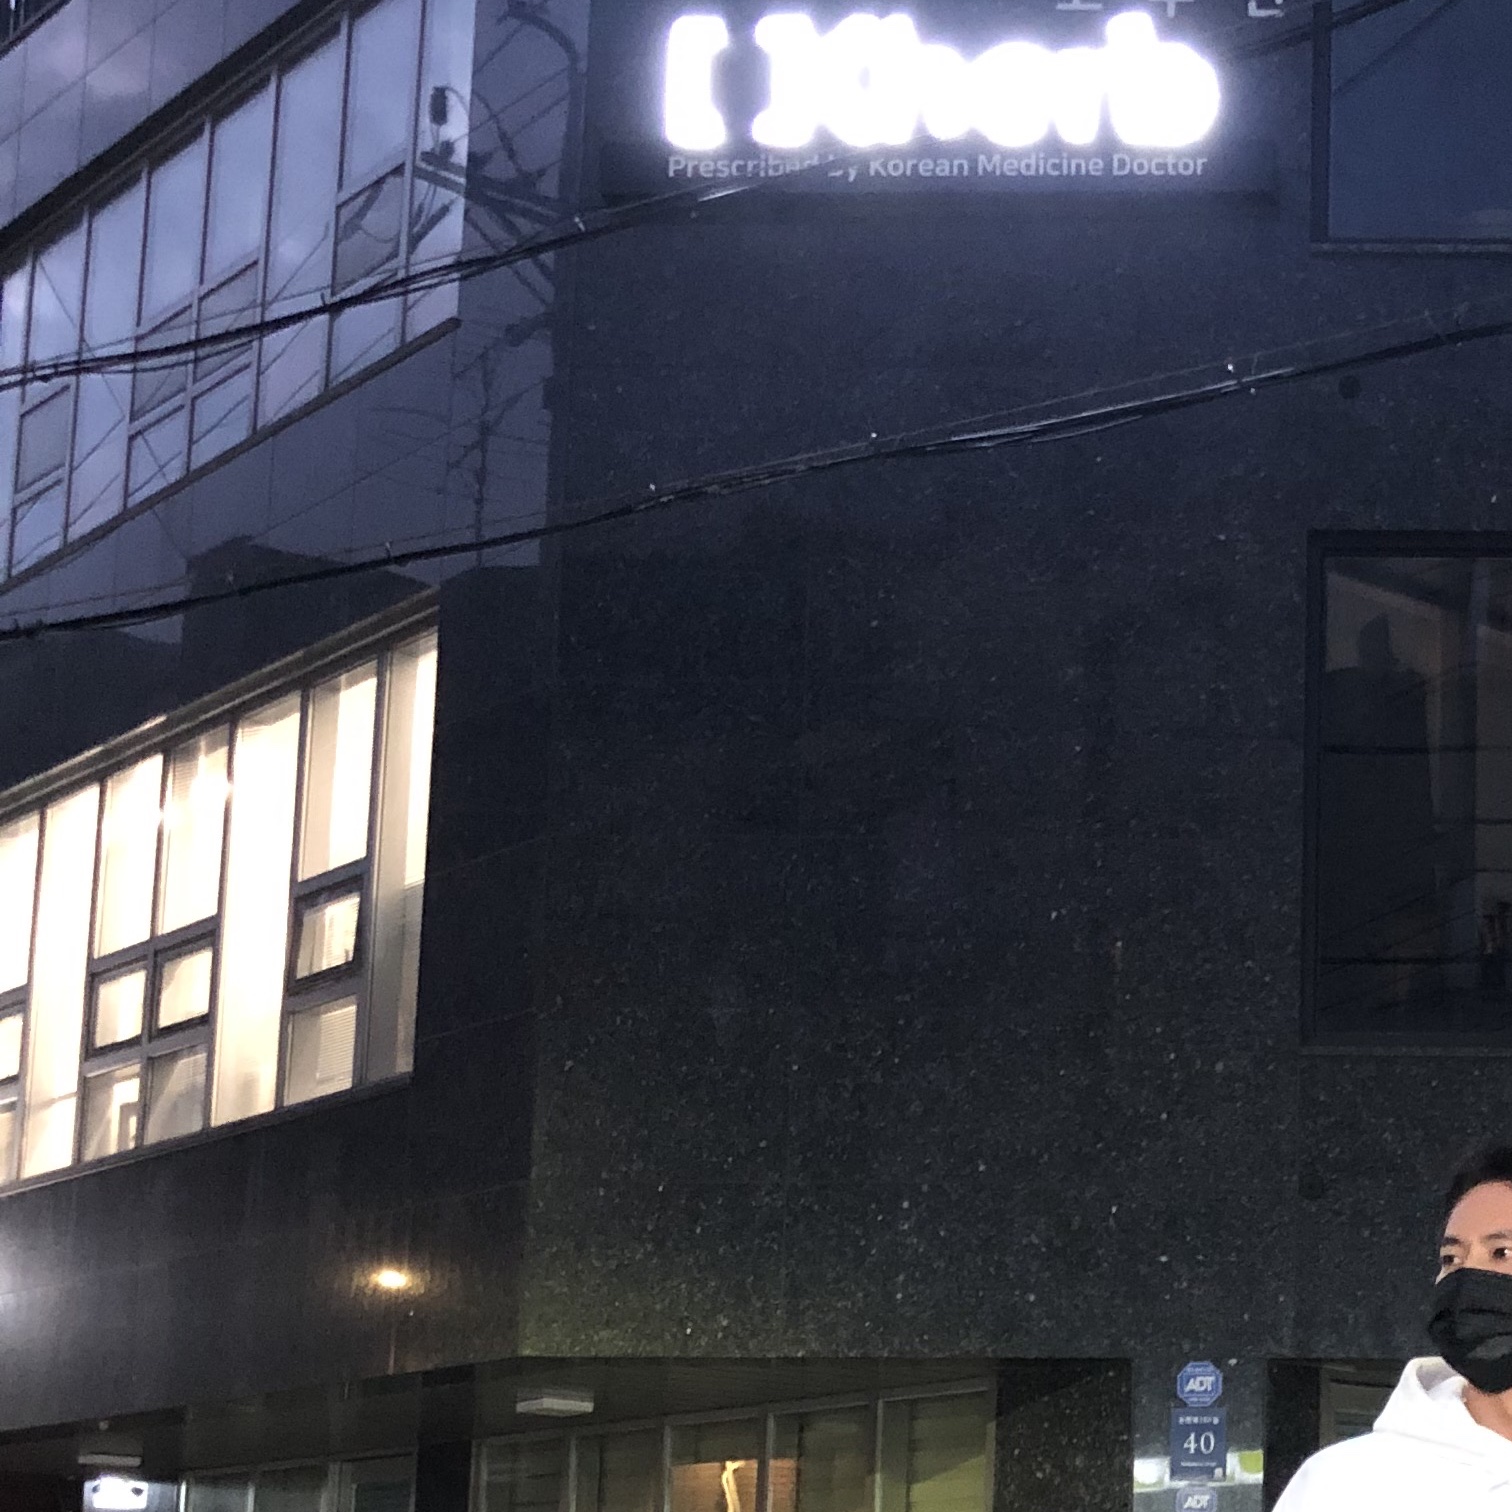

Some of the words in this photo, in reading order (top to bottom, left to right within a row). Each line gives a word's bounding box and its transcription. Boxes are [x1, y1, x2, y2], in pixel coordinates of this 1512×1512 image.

[868, 156, 969, 178] Korean
[977, 153, 1104, 177] Medicine
[1112, 154, 1208, 177] Doctor
[1184, 1376, 1216, 1392] ADT
[1183, 1432, 1215, 1454] 40
[1183, 1495, 1210, 1508] ADT
